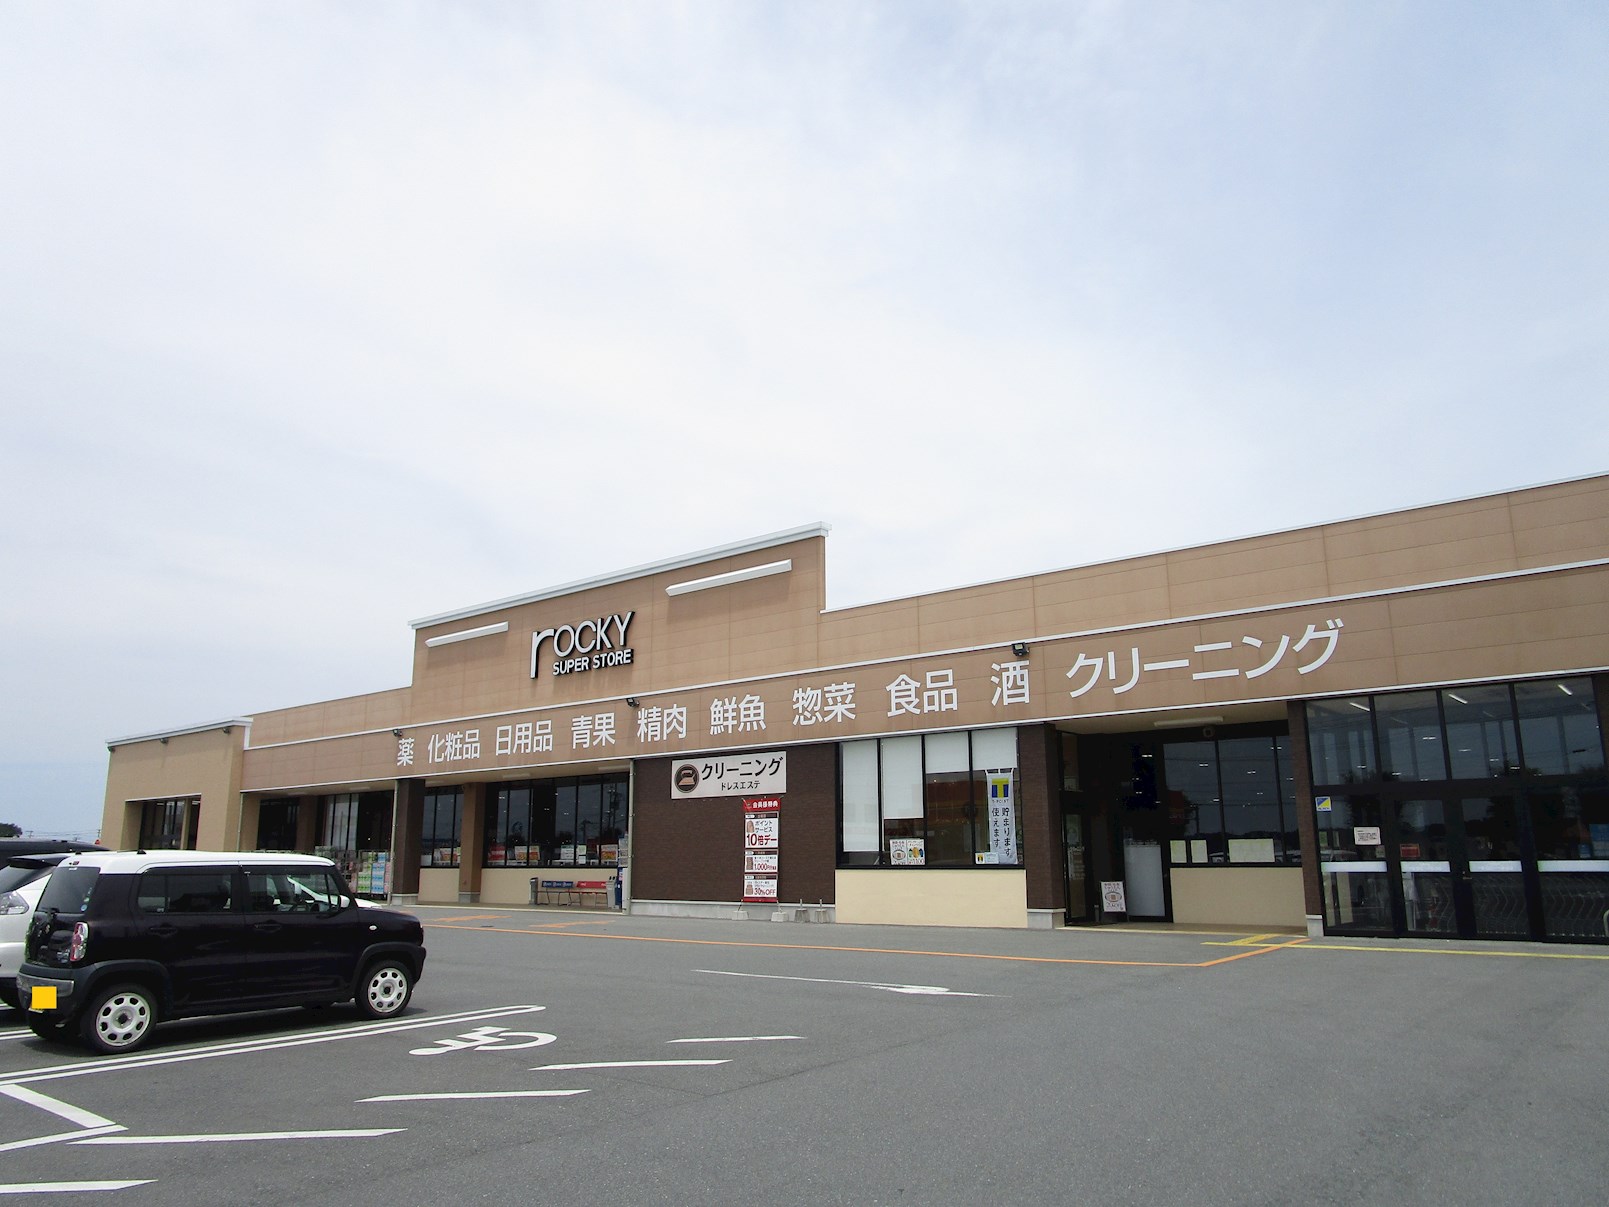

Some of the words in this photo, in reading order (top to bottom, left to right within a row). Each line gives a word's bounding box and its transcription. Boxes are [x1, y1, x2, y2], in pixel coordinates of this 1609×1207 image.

[552, 655, 589, 676] SUPER
[592, 648, 633, 670] STORE
[396, 736, 415, 767] 薬
[427, 728, 480, 764] 化粧品
[495, 719, 553, 756] 日用品
[570, 711, 616, 750] 青果
[636, 703, 687, 743] 精肉
[708, 693, 767, 736] 鮮魚
[791, 681, 857, 728] 惣菜
[885, 668, 959, 718] 食品
[990, 659, 1031, 707] 酒
[1065, 617, 1345, 699] クリーニング
[701, 756, 784, 780] クリーニング
[721, 780, 761, 791] ドレスエステ
[746, 833, 777, 846] 10倍デー
